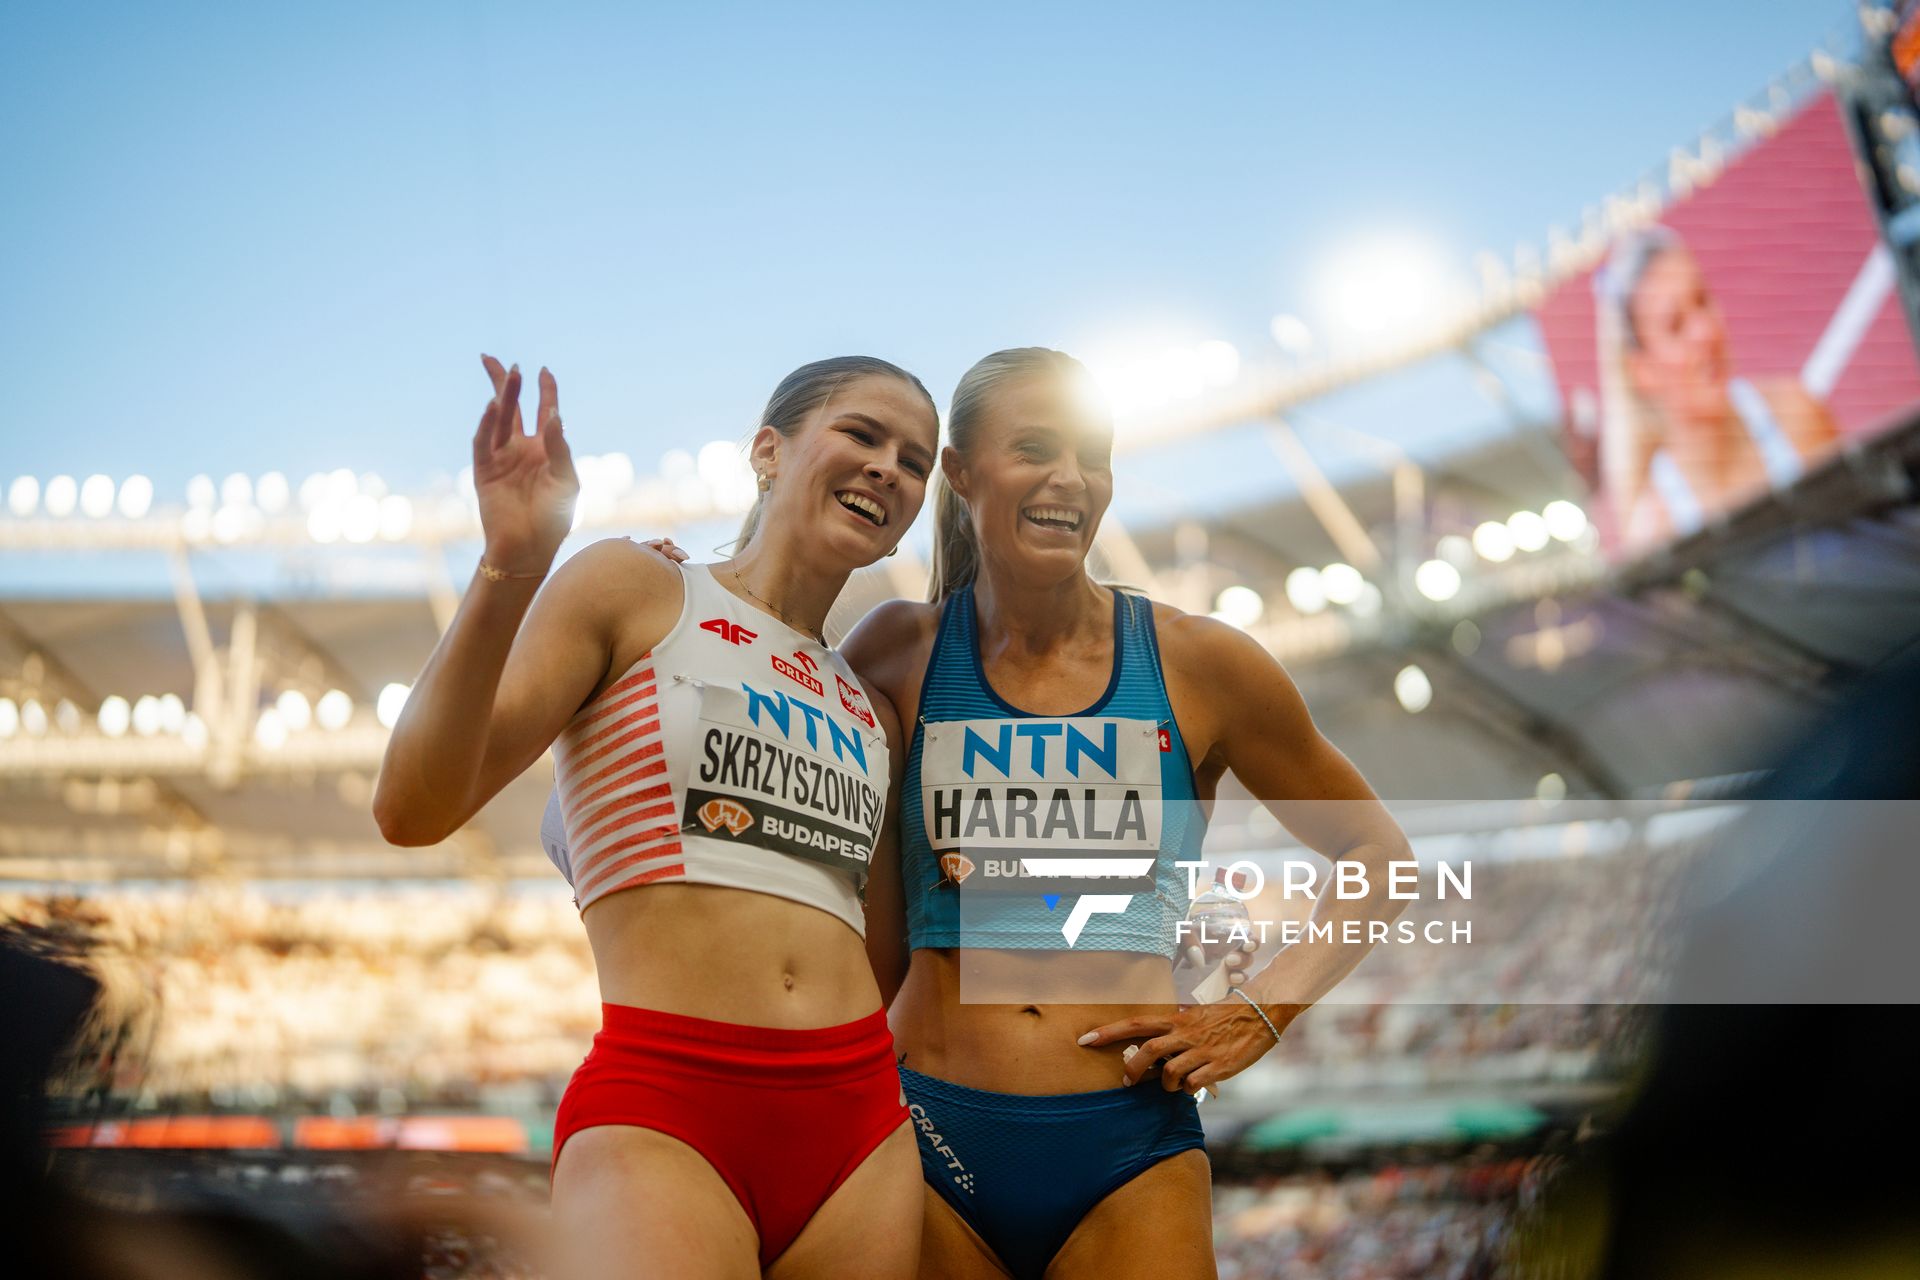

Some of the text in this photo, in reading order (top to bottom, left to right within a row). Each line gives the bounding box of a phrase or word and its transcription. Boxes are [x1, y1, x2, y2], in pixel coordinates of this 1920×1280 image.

[700, 618, 758, 646] 4F
[774, 659, 821, 694] ORLEN
[741, 681, 868, 777] NTN
[962, 723, 1117, 780] NTN
[934, 787, 1148, 841] HARALA
[909, 1104, 965, 1171] CRAFT
